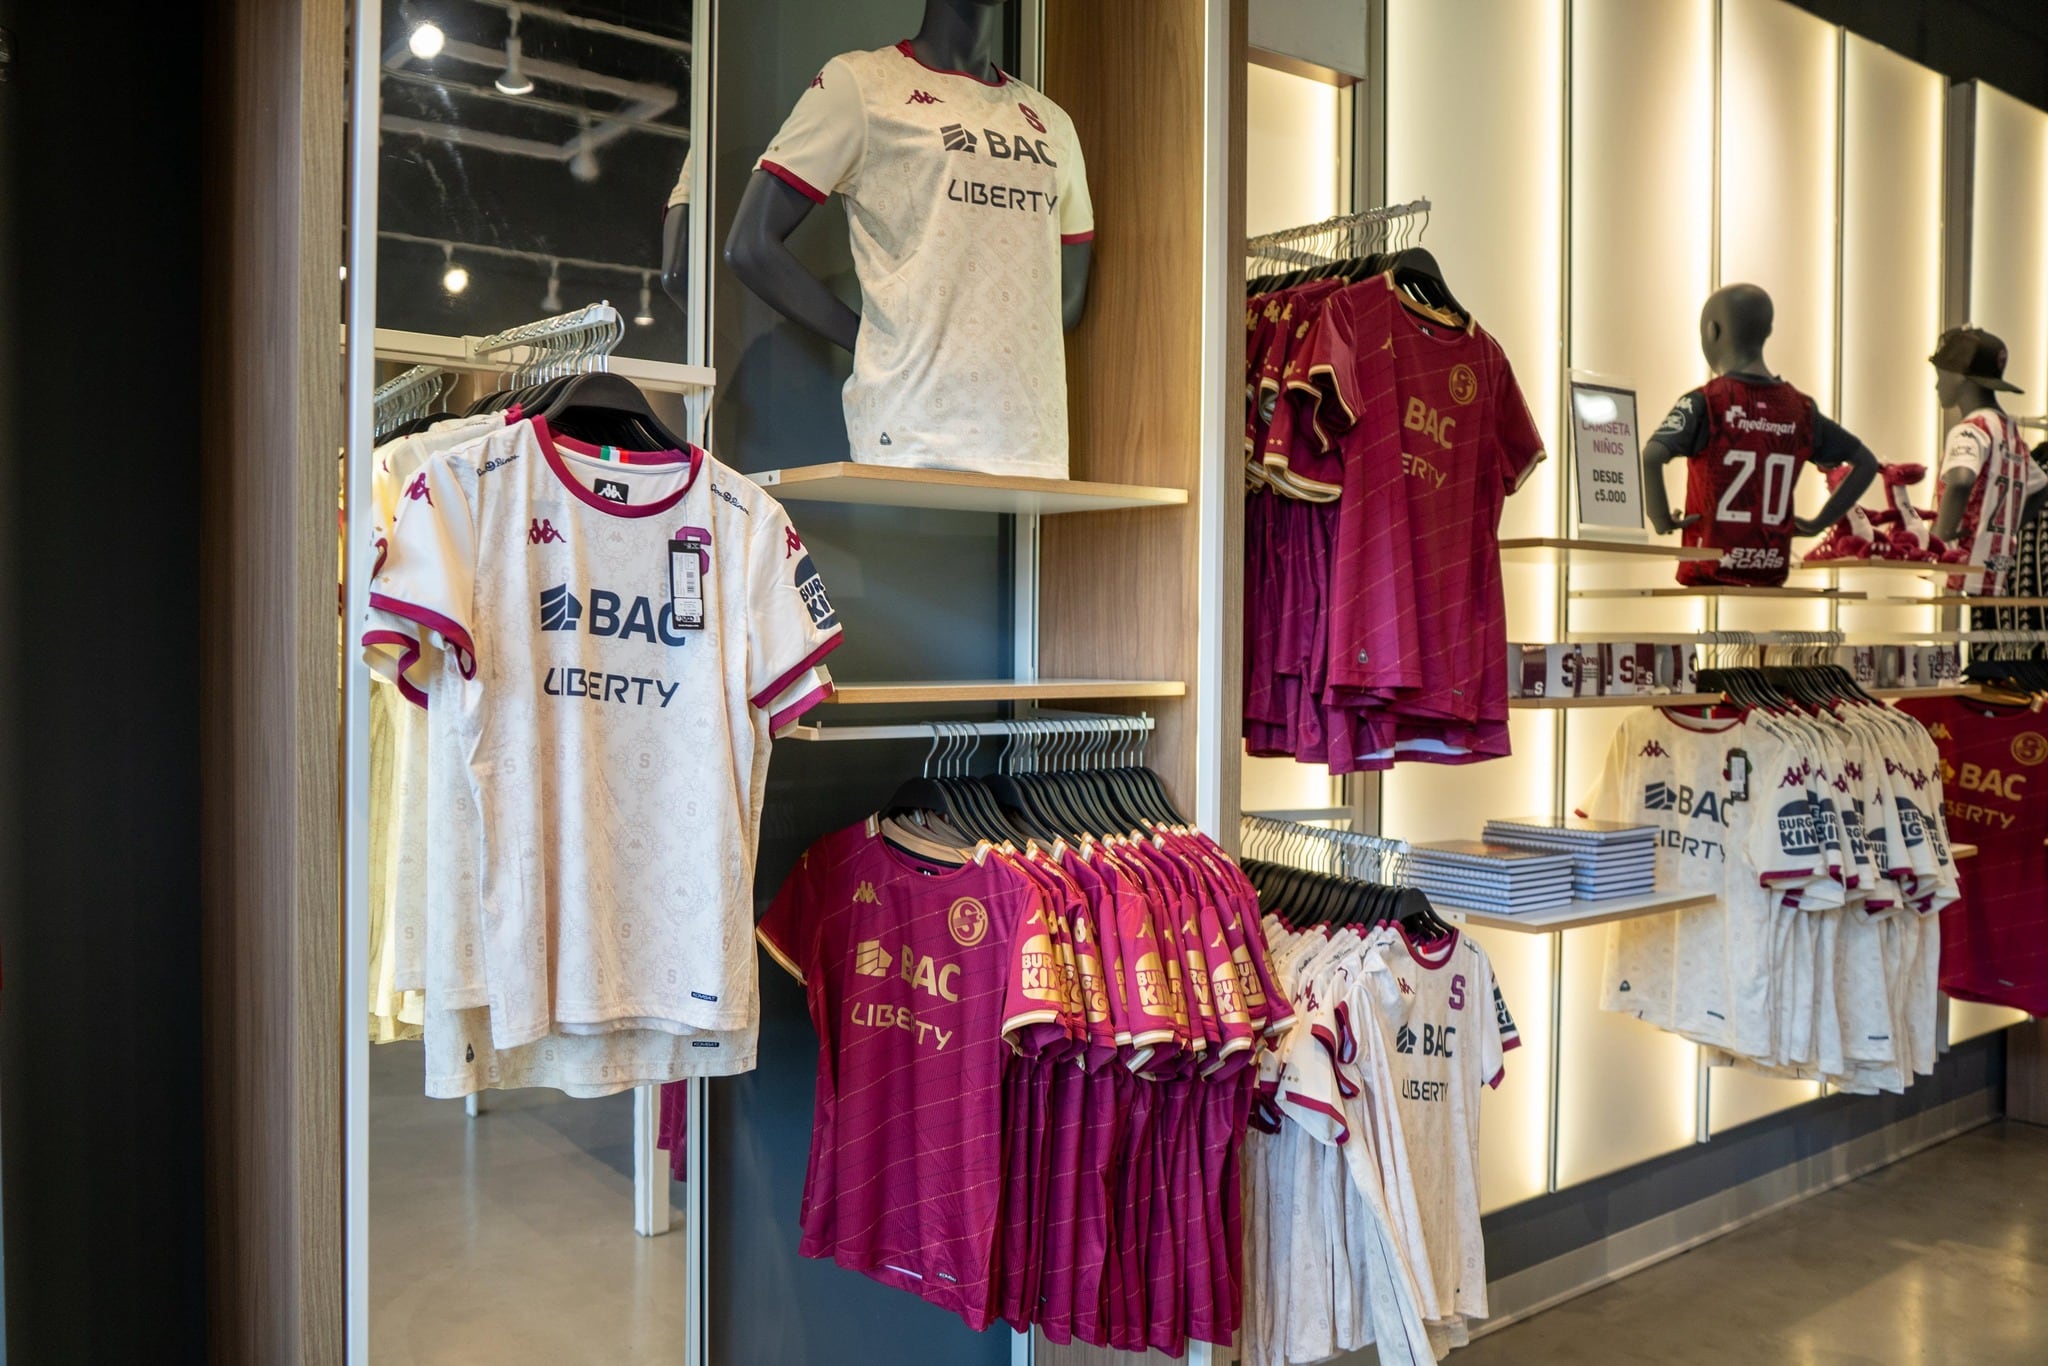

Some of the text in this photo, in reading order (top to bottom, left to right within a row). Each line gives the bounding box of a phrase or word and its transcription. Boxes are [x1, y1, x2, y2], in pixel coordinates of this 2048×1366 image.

[983, 128, 1057, 168] BAC
[948, 179, 1058, 215] LIBERTY
[1404, 397, 1456, 449] BAC
[1738, 417, 1796, 436] medismart
[1593, 438, 1624, 455] NIÑOS
[1402, 453, 1447, 489] ERTY
[1593, 469, 1624, 485] DESDE
[1716, 450, 1795, 526] 20
[1731, 547, 1779, 559] STAR
[1736, 557, 1784, 568] CARS
[800, 577, 824, 603] BUR
[590, 589, 685, 648] BAC
[806, 595, 831, 623] KI
[1620, 656, 1634, 683] S
[544, 667, 679, 708] LIBERTY
[1534, 681, 1544, 695] S
[1960, 762, 2027, 801] BAC
[1678, 784, 1733, 828] BAC
[1944, 800, 2015, 829] BERTY
[1778, 817, 1813, 831] BURG
[1780, 829, 1817, 847] KIN
[902, 944, 961, 1002] BAC
[1022, 953, 1052, 969] BUR
[1213, 980, 1239, 996] BUR
[1449, 974, 1466, 1010] S
[851, 1002, 952, 1051] LIBERTY
[1424, 1024, 1456, 1058] BAC
[1403, 1079, 1449, 1102] LIBERTY
